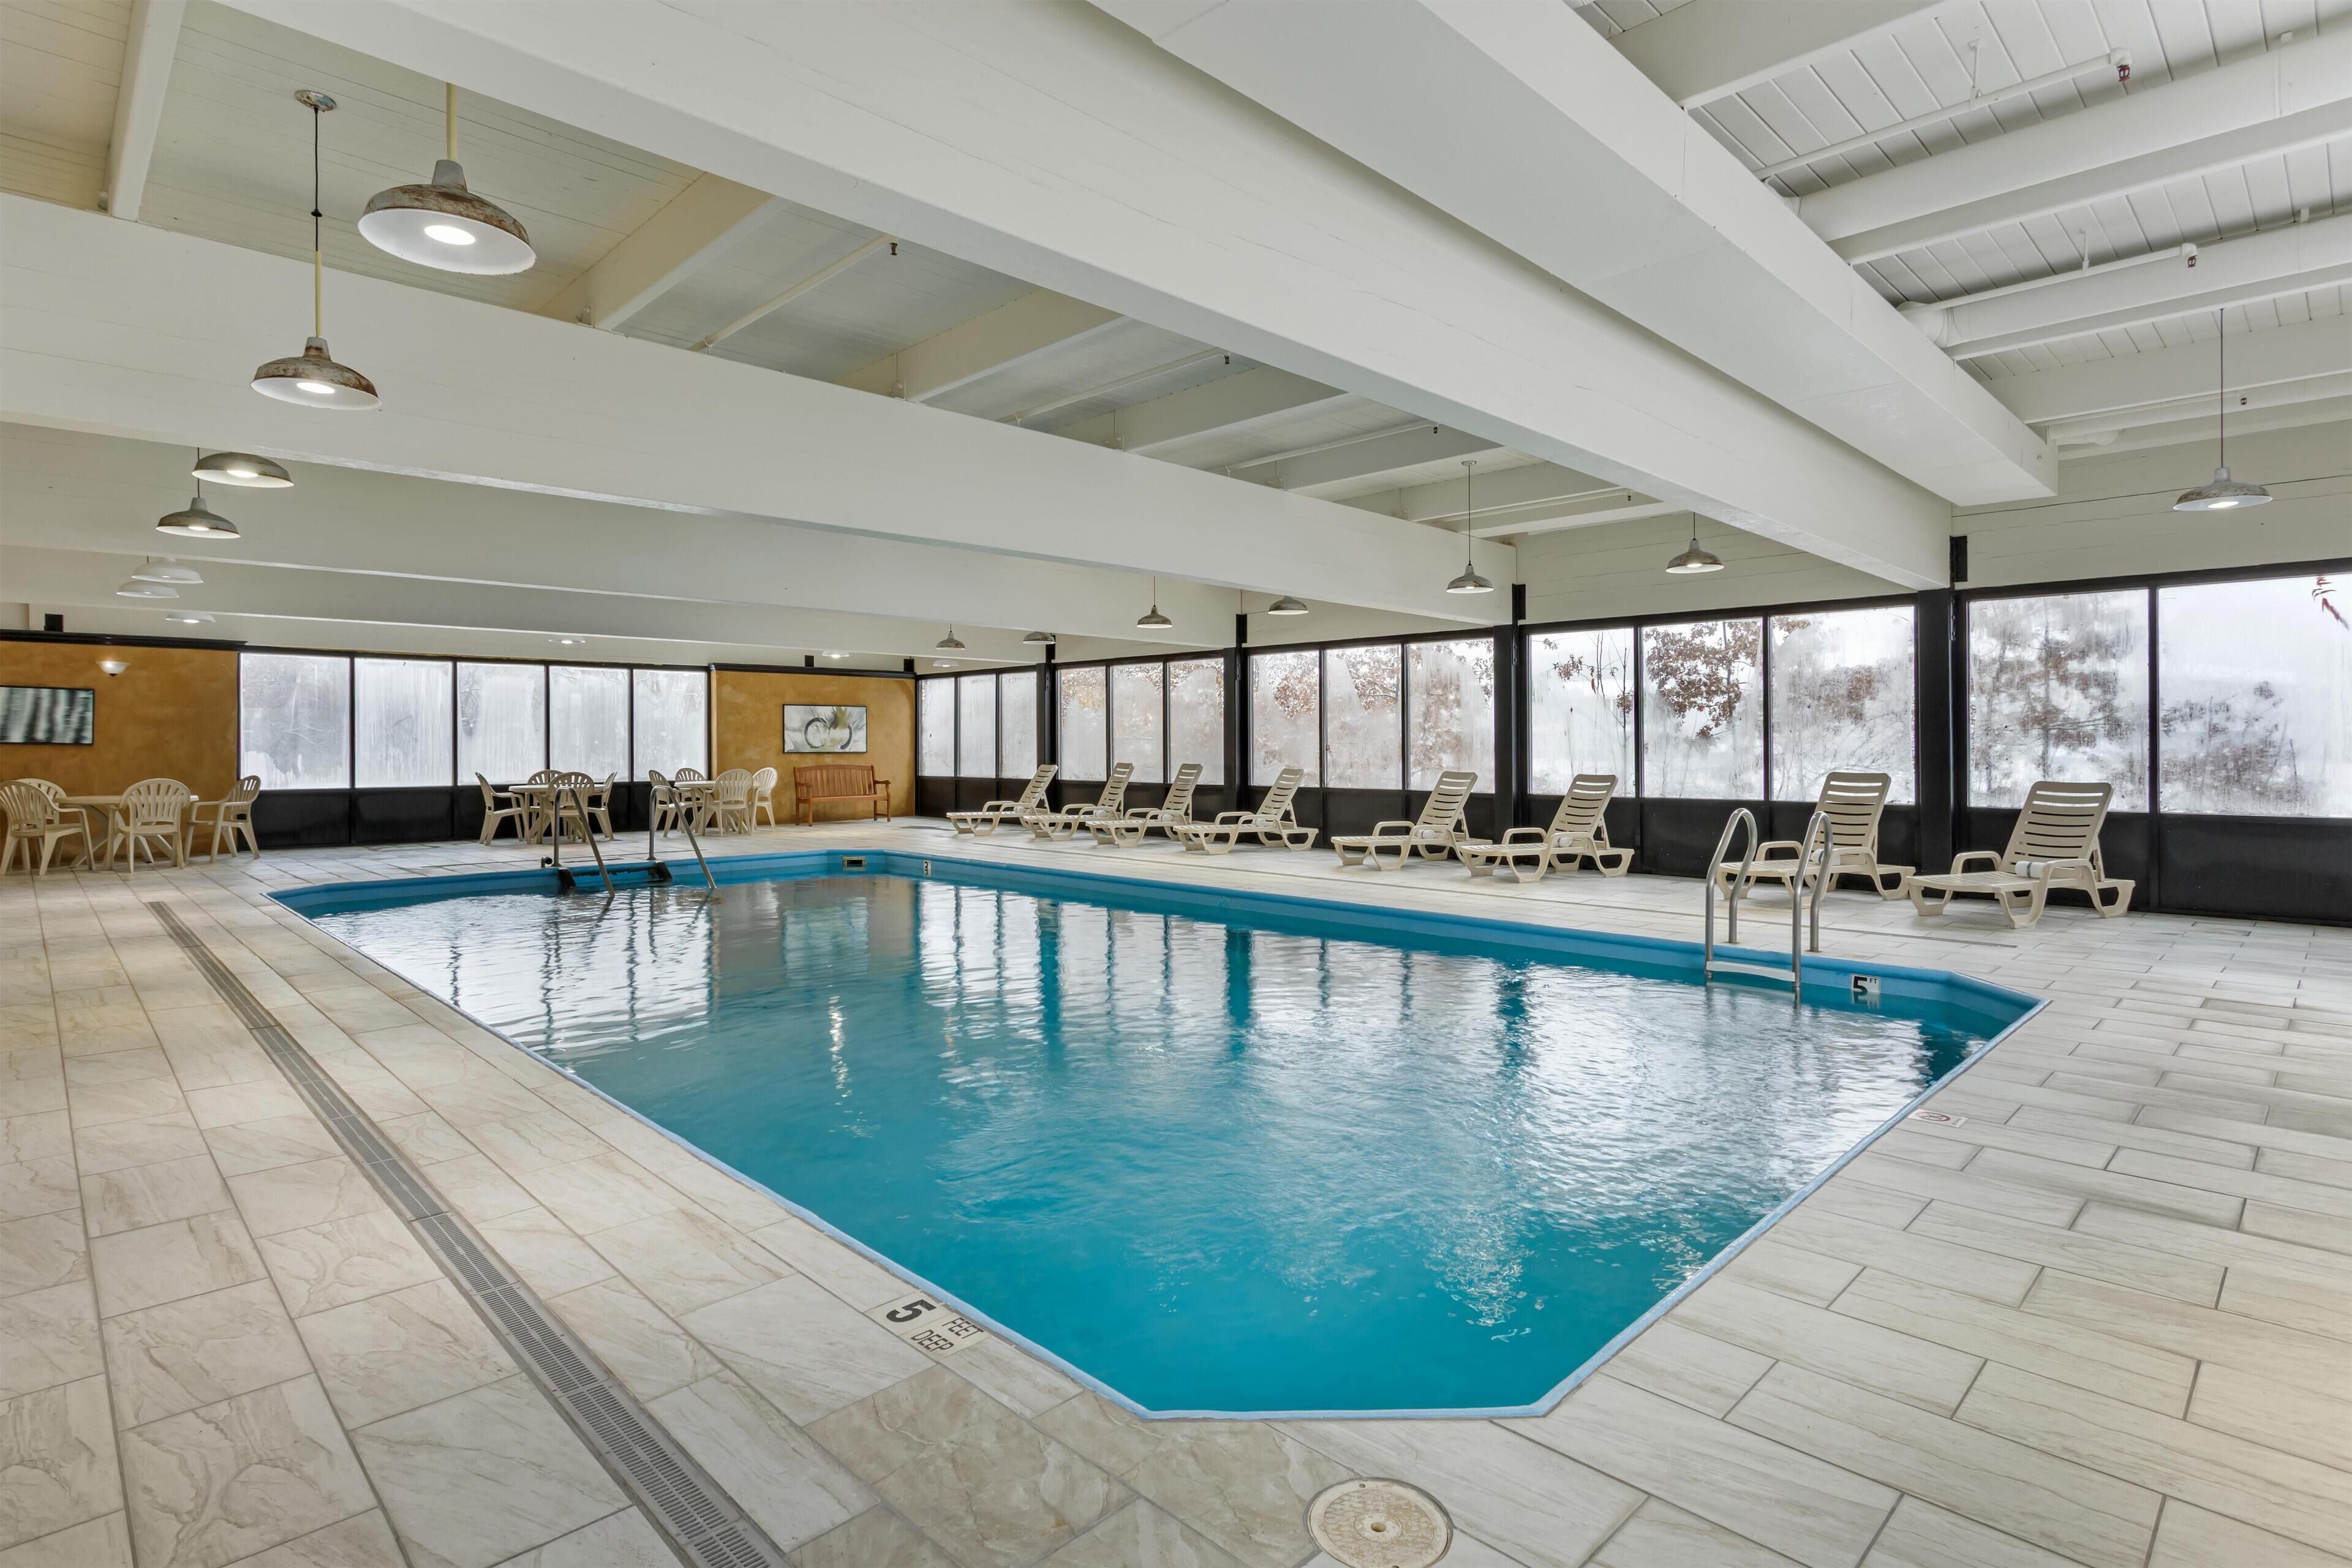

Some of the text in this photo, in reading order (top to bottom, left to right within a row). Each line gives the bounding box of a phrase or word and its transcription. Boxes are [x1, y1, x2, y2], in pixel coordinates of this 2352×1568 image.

[1853, 976, 1868, 995] 5
[886, 1299, 937, 1322] 5
[941, 1317, 984, 1339] FEET
[910, 1329, 954, 1352] DEEP
